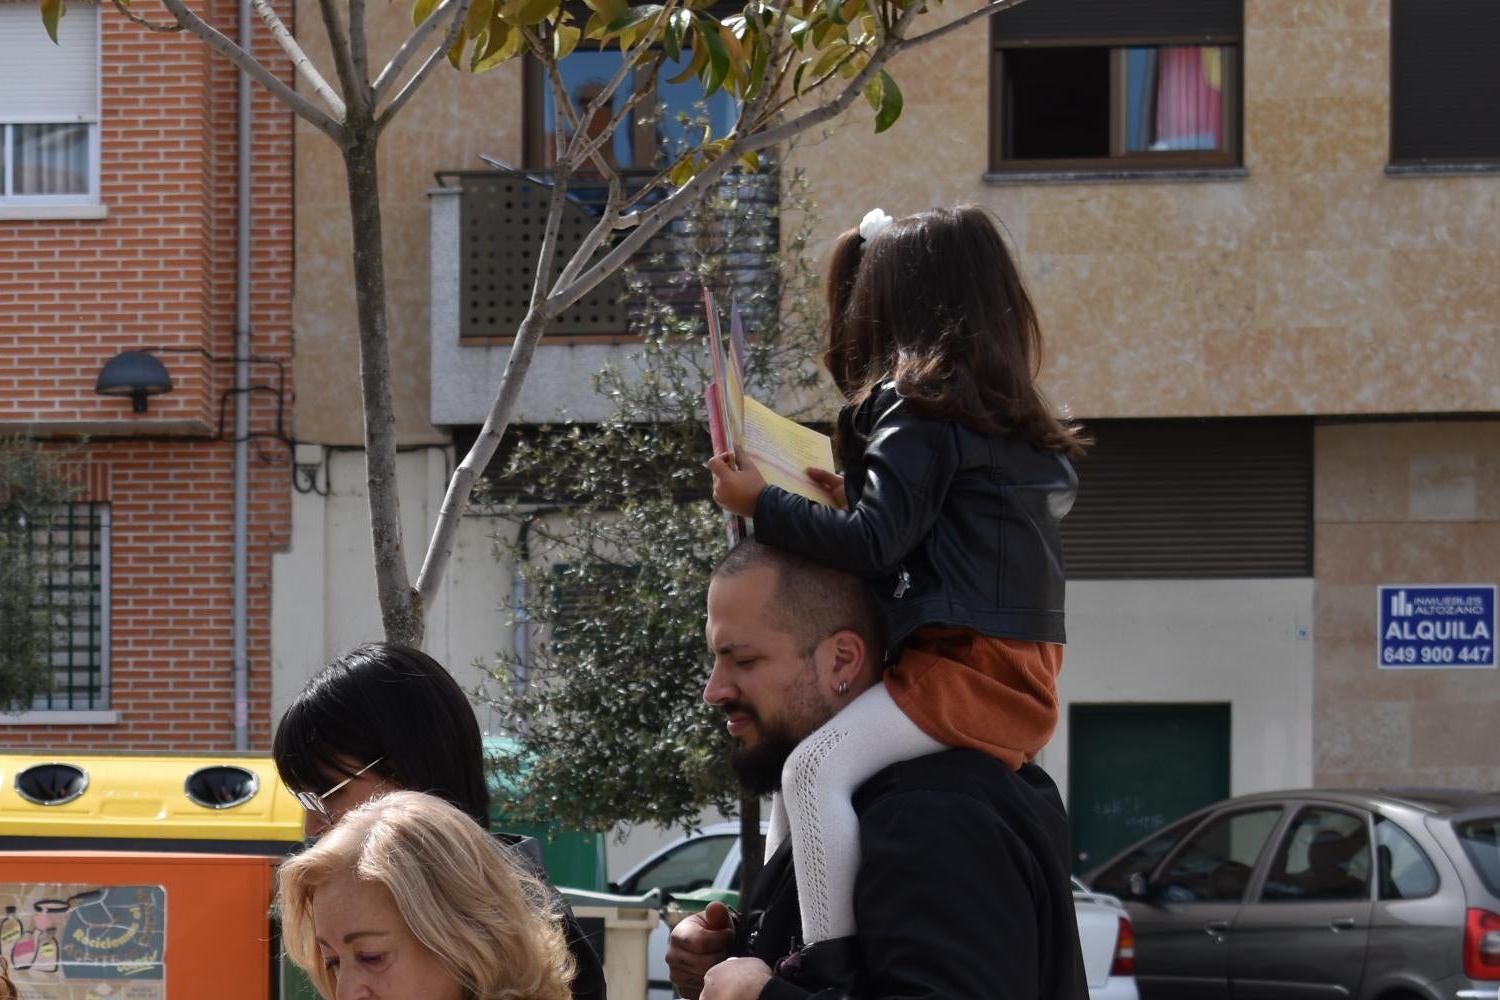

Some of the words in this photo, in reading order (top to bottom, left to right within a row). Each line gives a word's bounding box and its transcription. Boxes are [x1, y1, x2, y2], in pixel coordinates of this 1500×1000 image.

[1414, 606, 1484, 615] ALTOZANO
[1385, 621, 1489, 640] ALQUILA
[1384, 646, 1416, 662] 649
[1421, 647, 1454, 662] 900
[1458, 647, 1490, 662] 447
